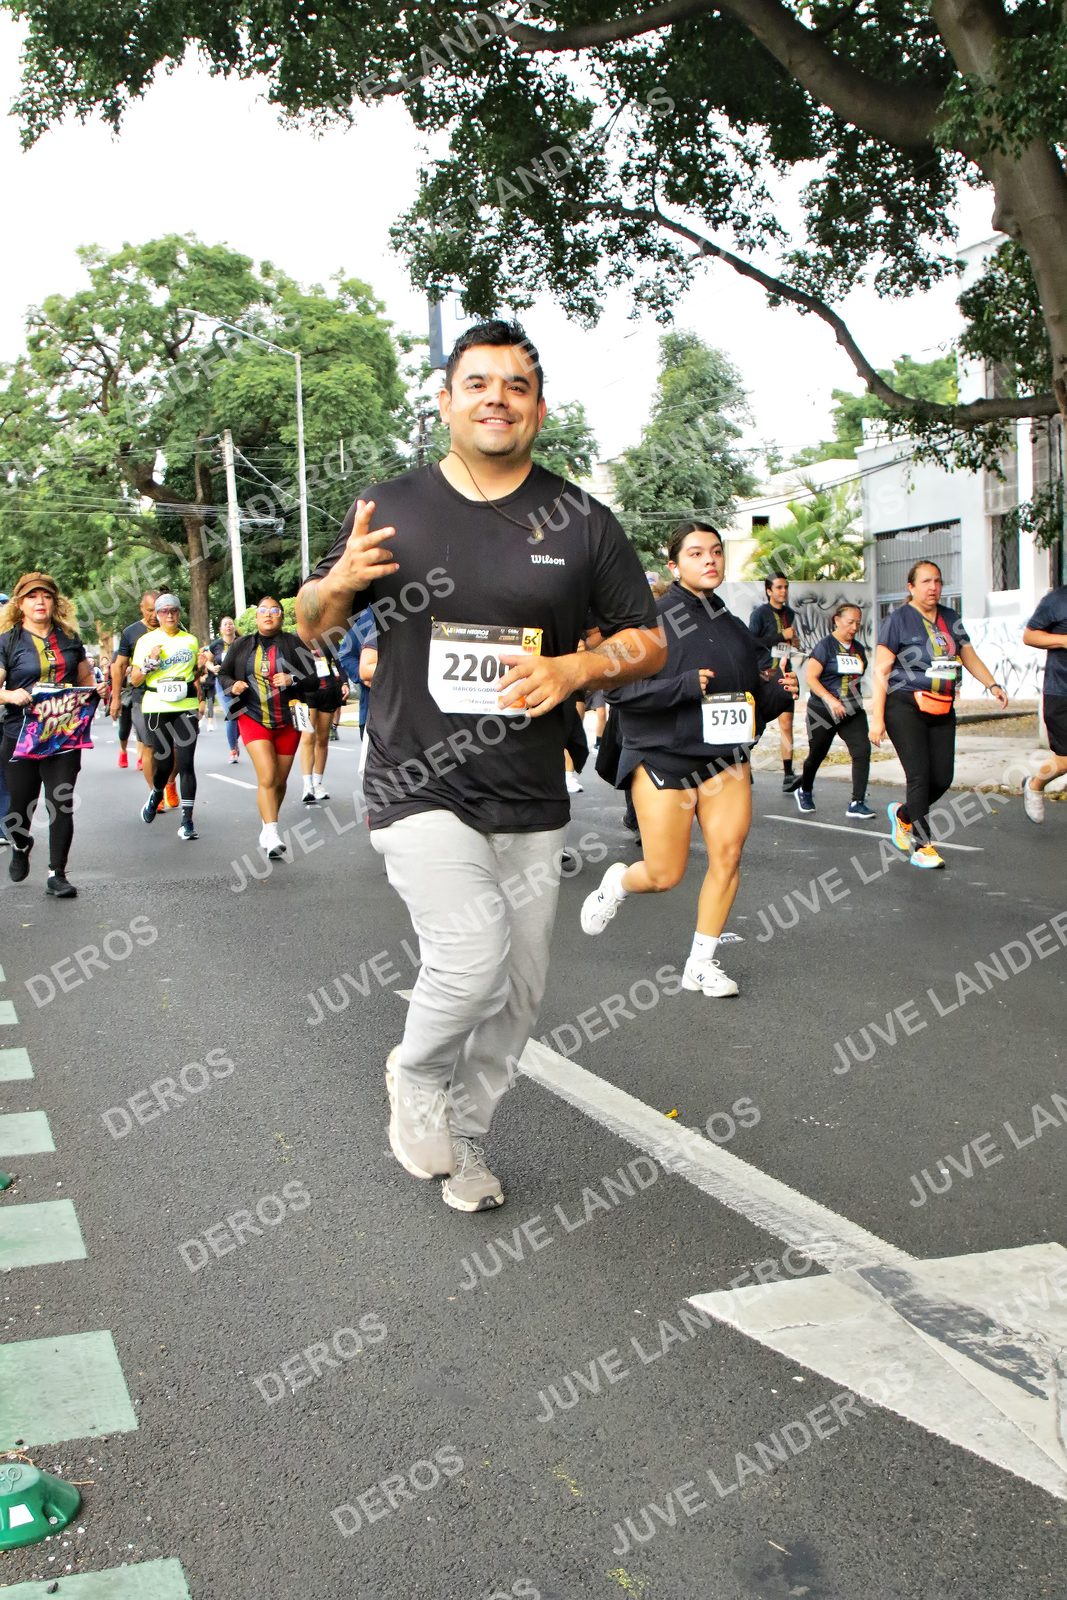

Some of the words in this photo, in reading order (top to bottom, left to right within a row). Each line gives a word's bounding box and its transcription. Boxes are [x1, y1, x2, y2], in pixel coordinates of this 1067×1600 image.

[530, 554, 566, 566] Wilson
[524, 635, 538, 645] 5K
[711, 708, 747, 726] 5730
